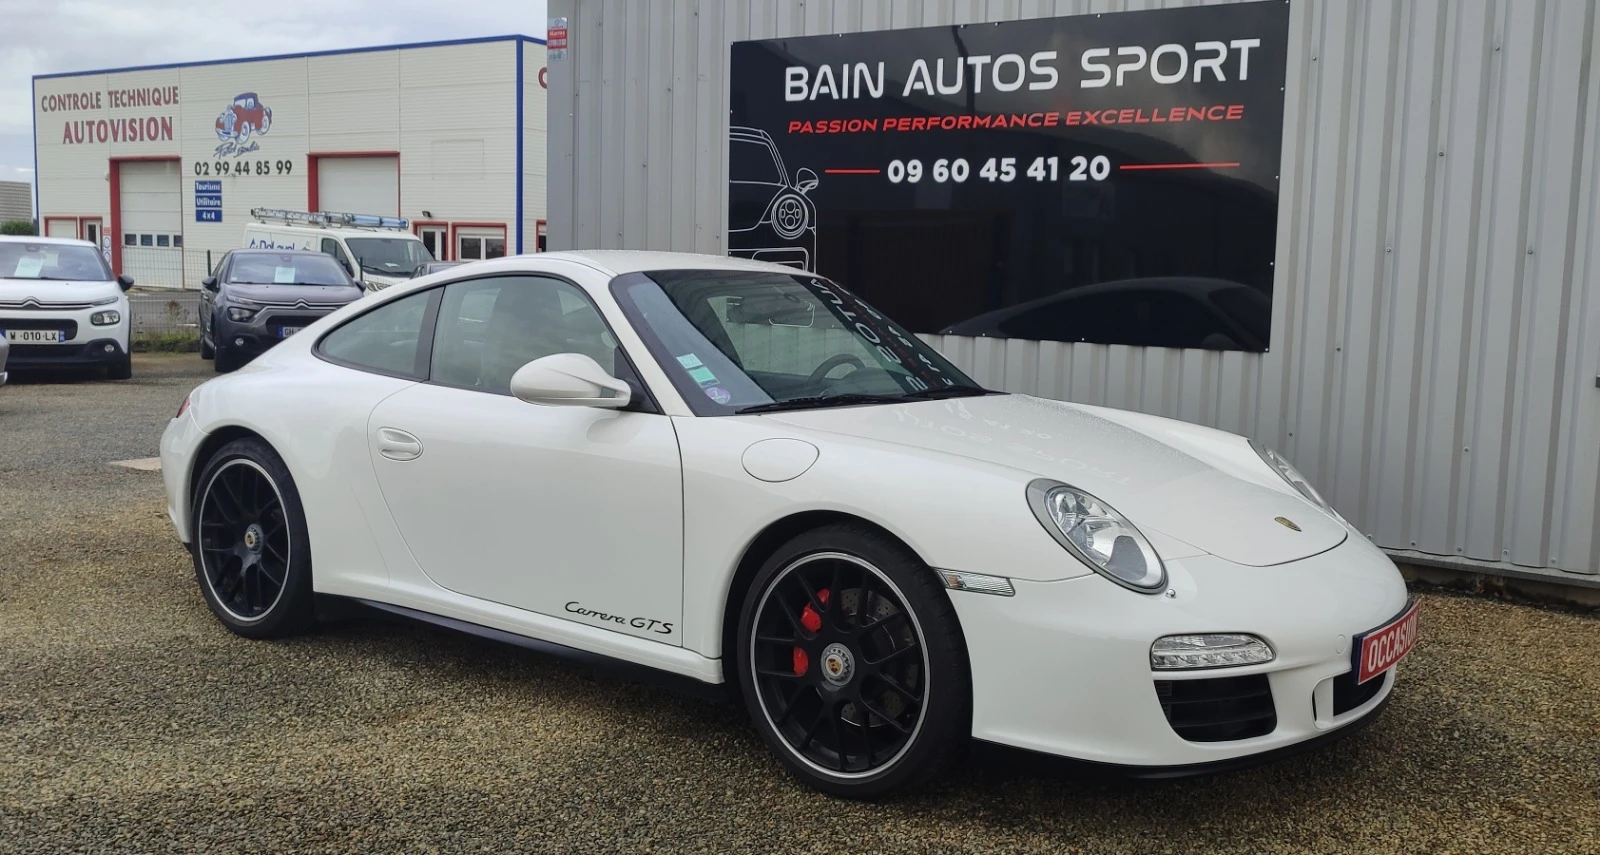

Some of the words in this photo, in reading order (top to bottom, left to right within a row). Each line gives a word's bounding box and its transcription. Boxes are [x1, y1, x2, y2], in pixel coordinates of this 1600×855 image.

[785, 61, 885, 102] BAIN
[902, 51, 1059, 98] AUTOS
[1080, 38, 1261, 89] SPORT
[41, 91, 102, 112] CONTROLE
[107, 86, 179, 109] TECHNIQUE
[63, 116, 173, 145] AUTOVISION
[788, 117, 878, 135] PASSION
[882, 111, 1060, 132] PERFORMANCE
[1065, 104, 1245, 126] EXCELLENCE
[194, 161, 210, 176] 02
[214, 161, 230, 175] 99
[234, 161, 250, 175] 44
[256, 160, 270, 175] 85
[276, 159, 293, 175] 99
[887, 159, 920, 183] 09
[932, 158, 970, 183] 60
[979, 157, 1017, 182] 45
[1026, 156, 1058, 182] 41
[1070, 155, 1111, 181] 20
[195, 182, 221, 191] Tourisme
[196, 198, 221, 206] Utilitaire
[564, 601, 626, 625] Carrera
[630, 617, 674, 635] GTS
